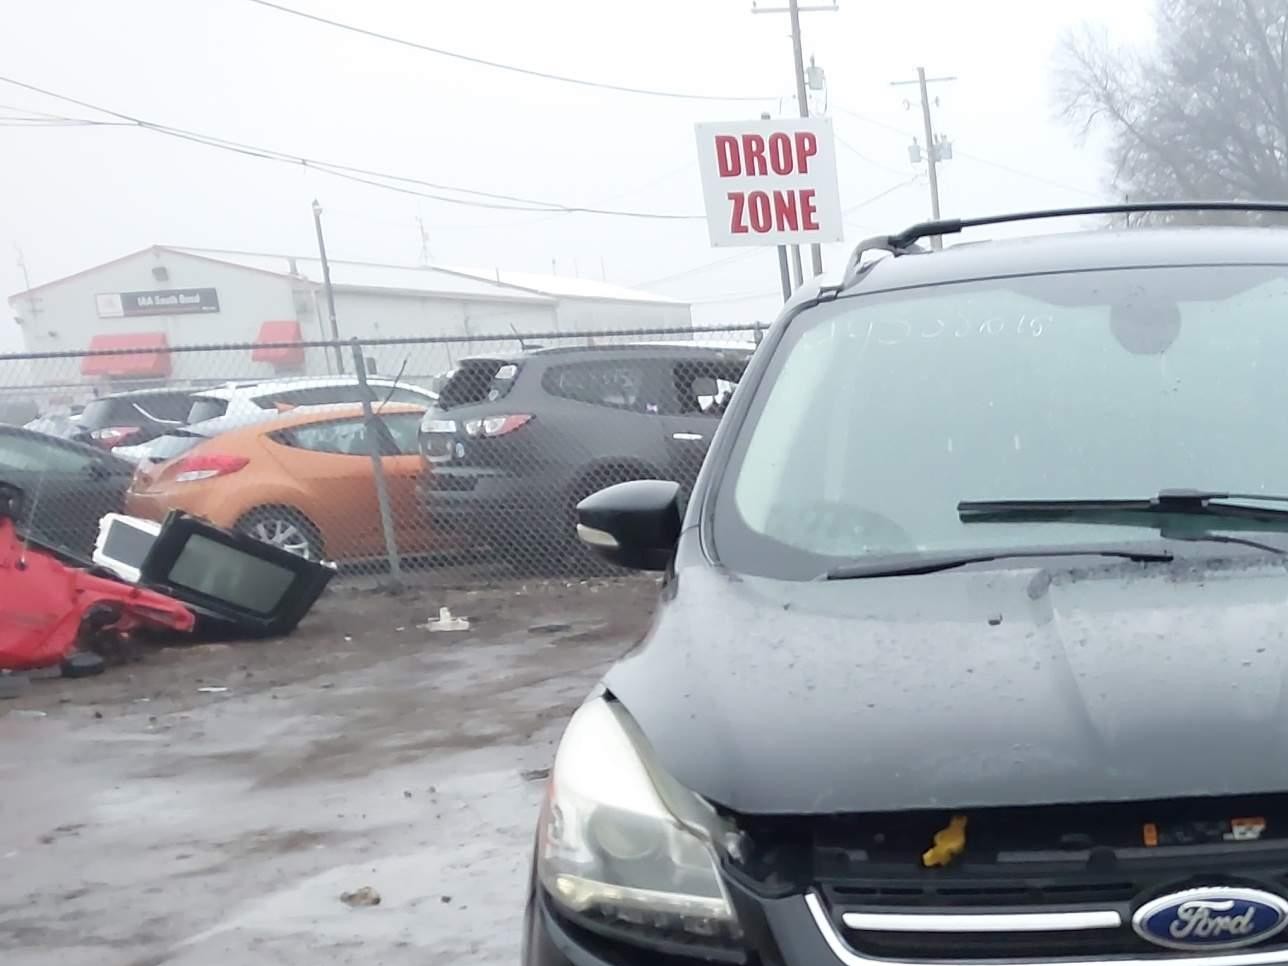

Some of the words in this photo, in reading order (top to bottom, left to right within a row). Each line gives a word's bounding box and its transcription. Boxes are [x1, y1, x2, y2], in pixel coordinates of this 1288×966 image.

[714, 131, 818, 178] DROP
[727, 188, 820, 234] ZONE
[1169, 900, 1255, 938] Ford
